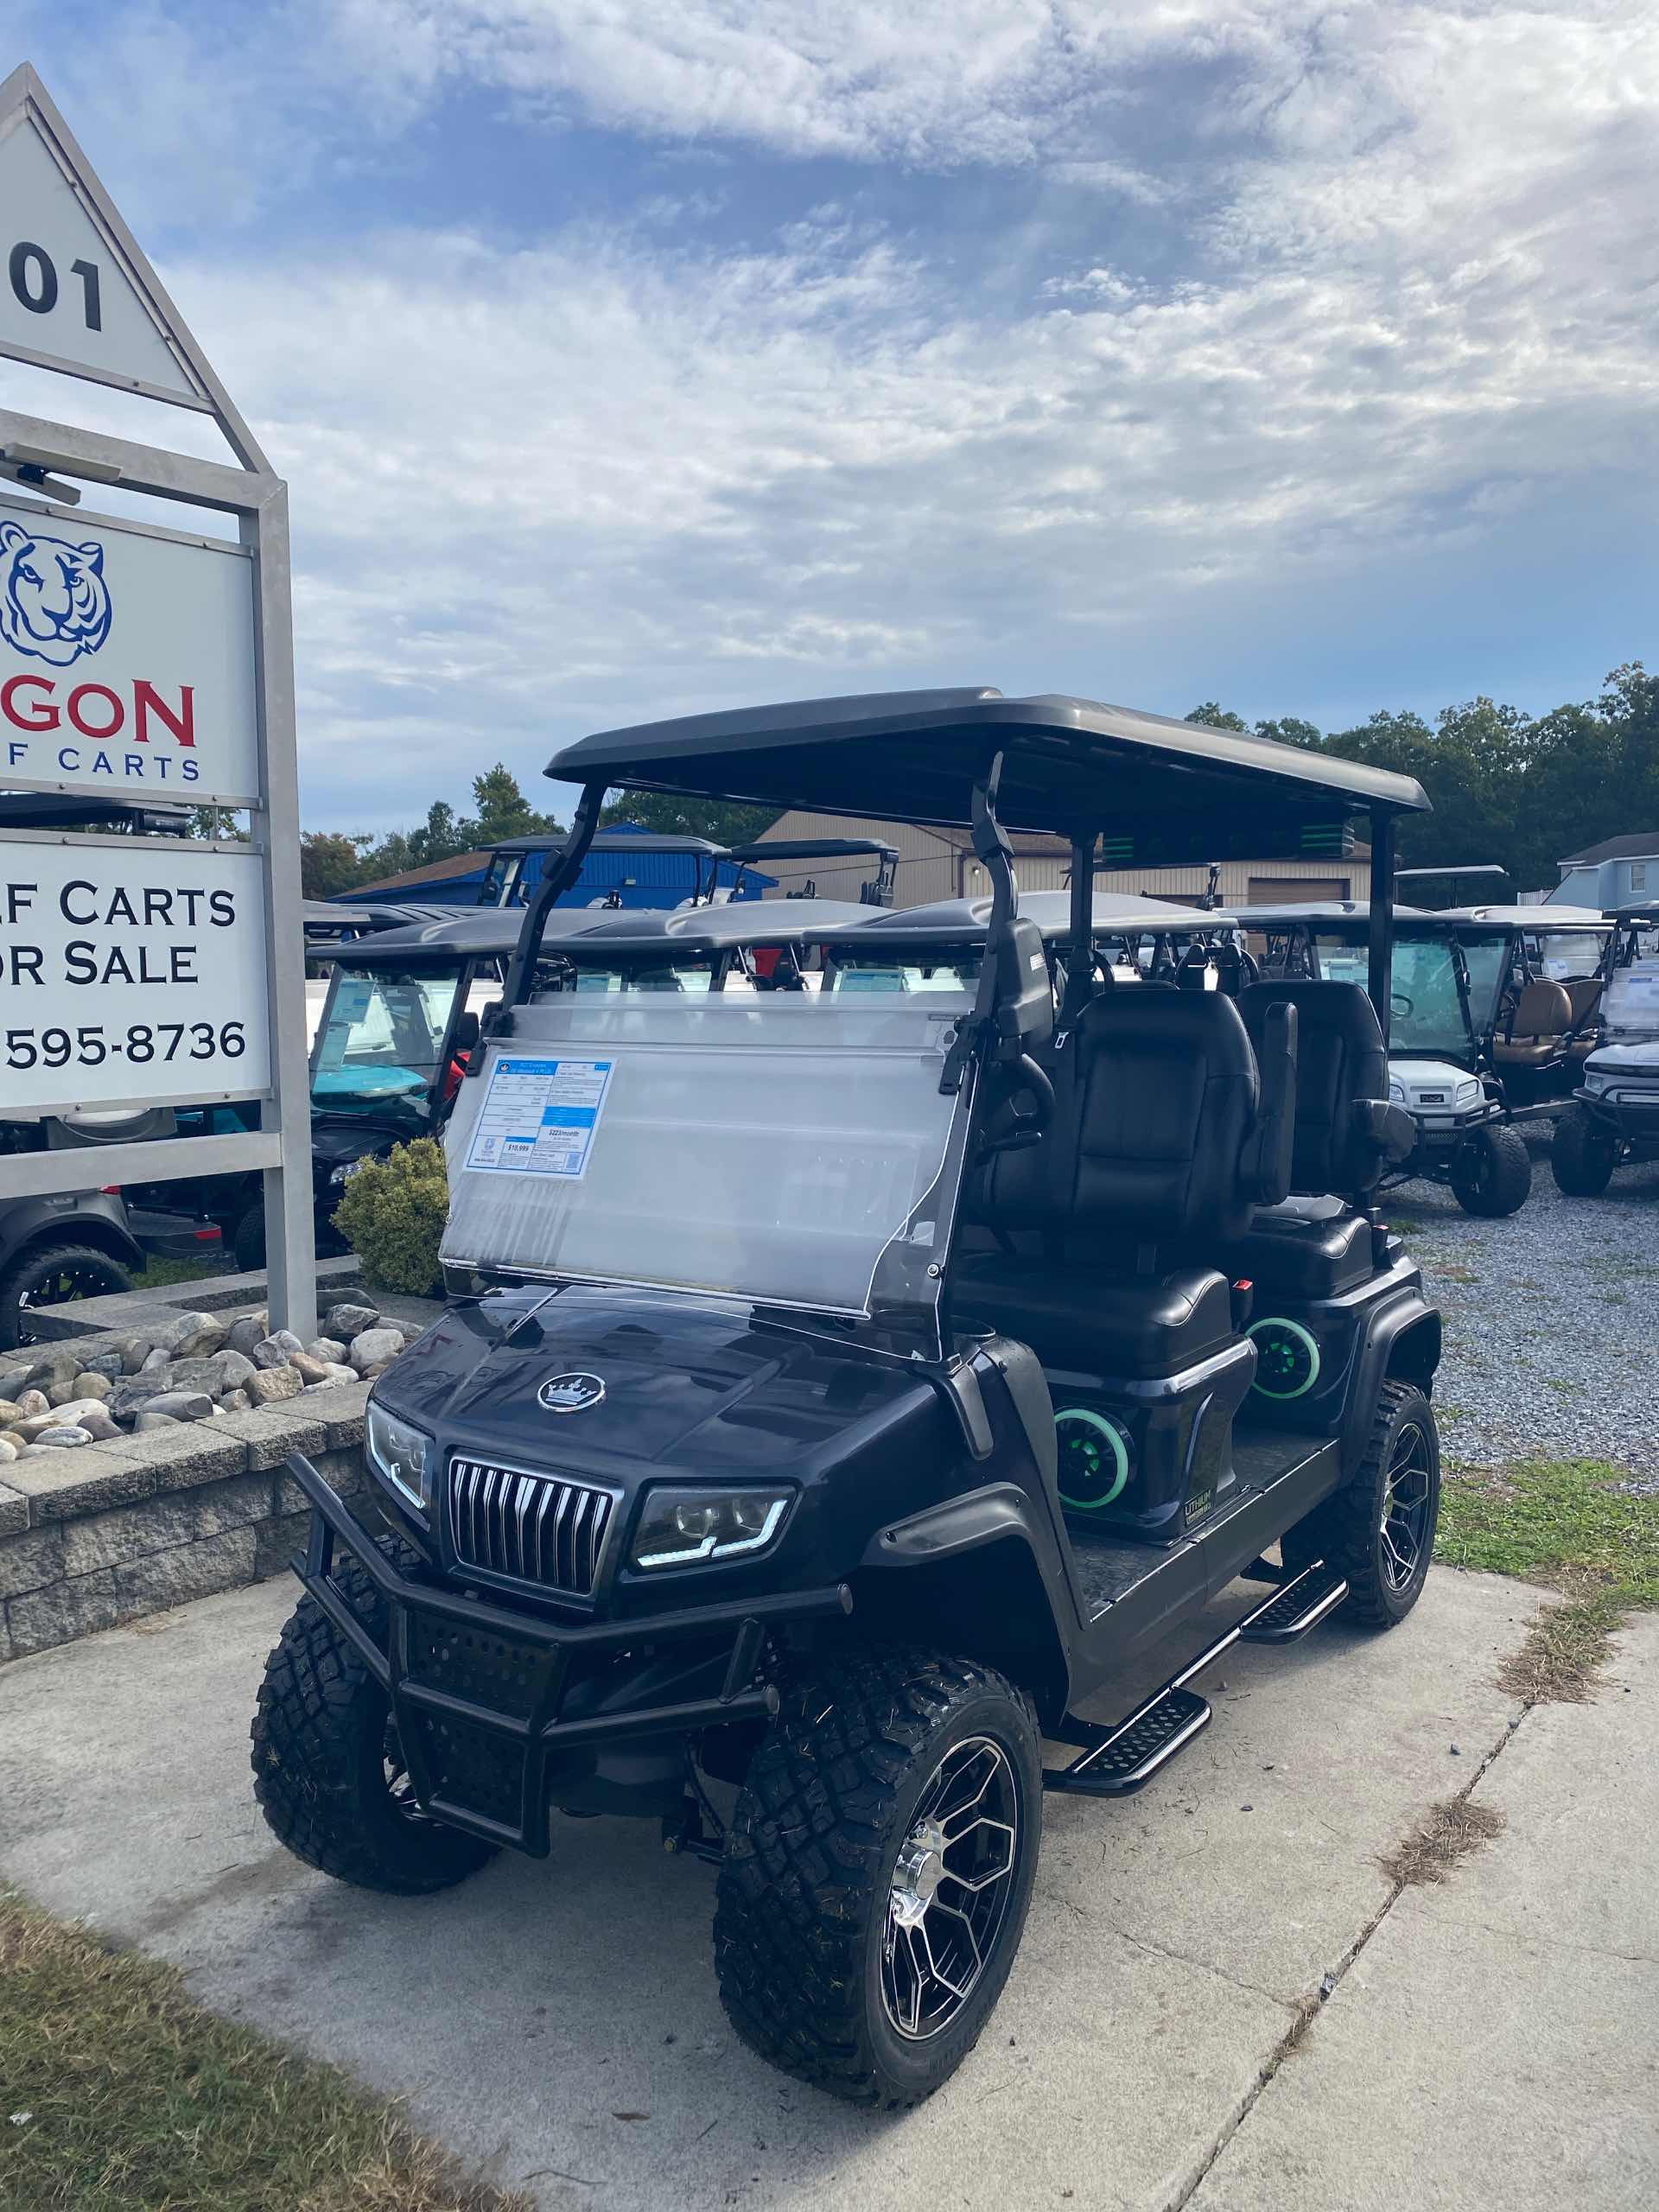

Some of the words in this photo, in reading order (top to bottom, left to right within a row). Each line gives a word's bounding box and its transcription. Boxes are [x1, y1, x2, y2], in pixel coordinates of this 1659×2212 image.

[9, 241, 102, 332] 01
[0, 674, 197, 747] GON
[9, 742, 29, 766] F
[58, 747, 200, 781] CARTS
[0, 883, 38, 925] F
[60, 880, 236, 927] CARTS
[0, 945, 46, 985] R
[64, 940, 199, 985] SALE
[5, 1021, 246, 1070] 595-8736
